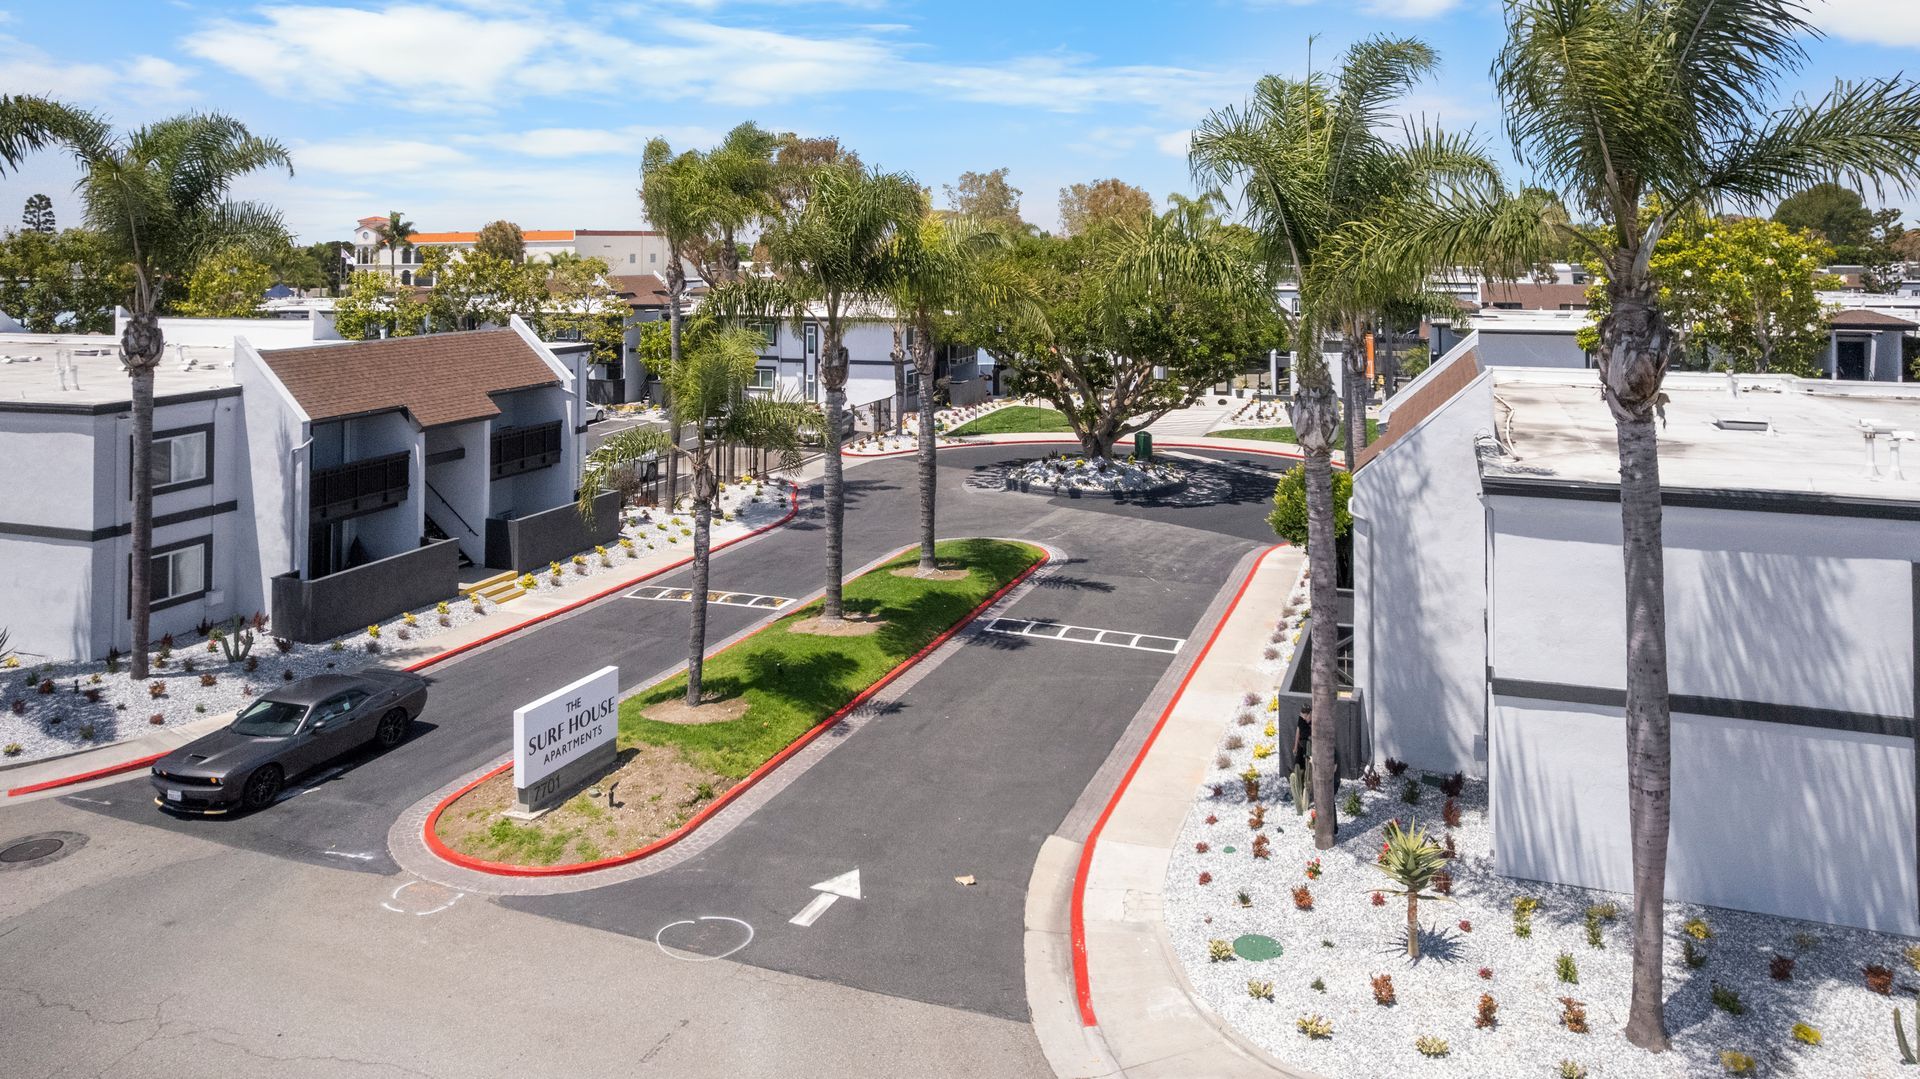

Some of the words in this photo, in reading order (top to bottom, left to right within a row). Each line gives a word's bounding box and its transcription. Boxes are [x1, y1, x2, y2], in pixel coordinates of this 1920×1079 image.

[566, 697, 582, 713] THE
[528, 722, 565, 756] SURF
[569, 696, 615, 734] HOUSE
[544, 725, 603, 765] APARTMENTS
[534, 775, 561, 802] 7701
